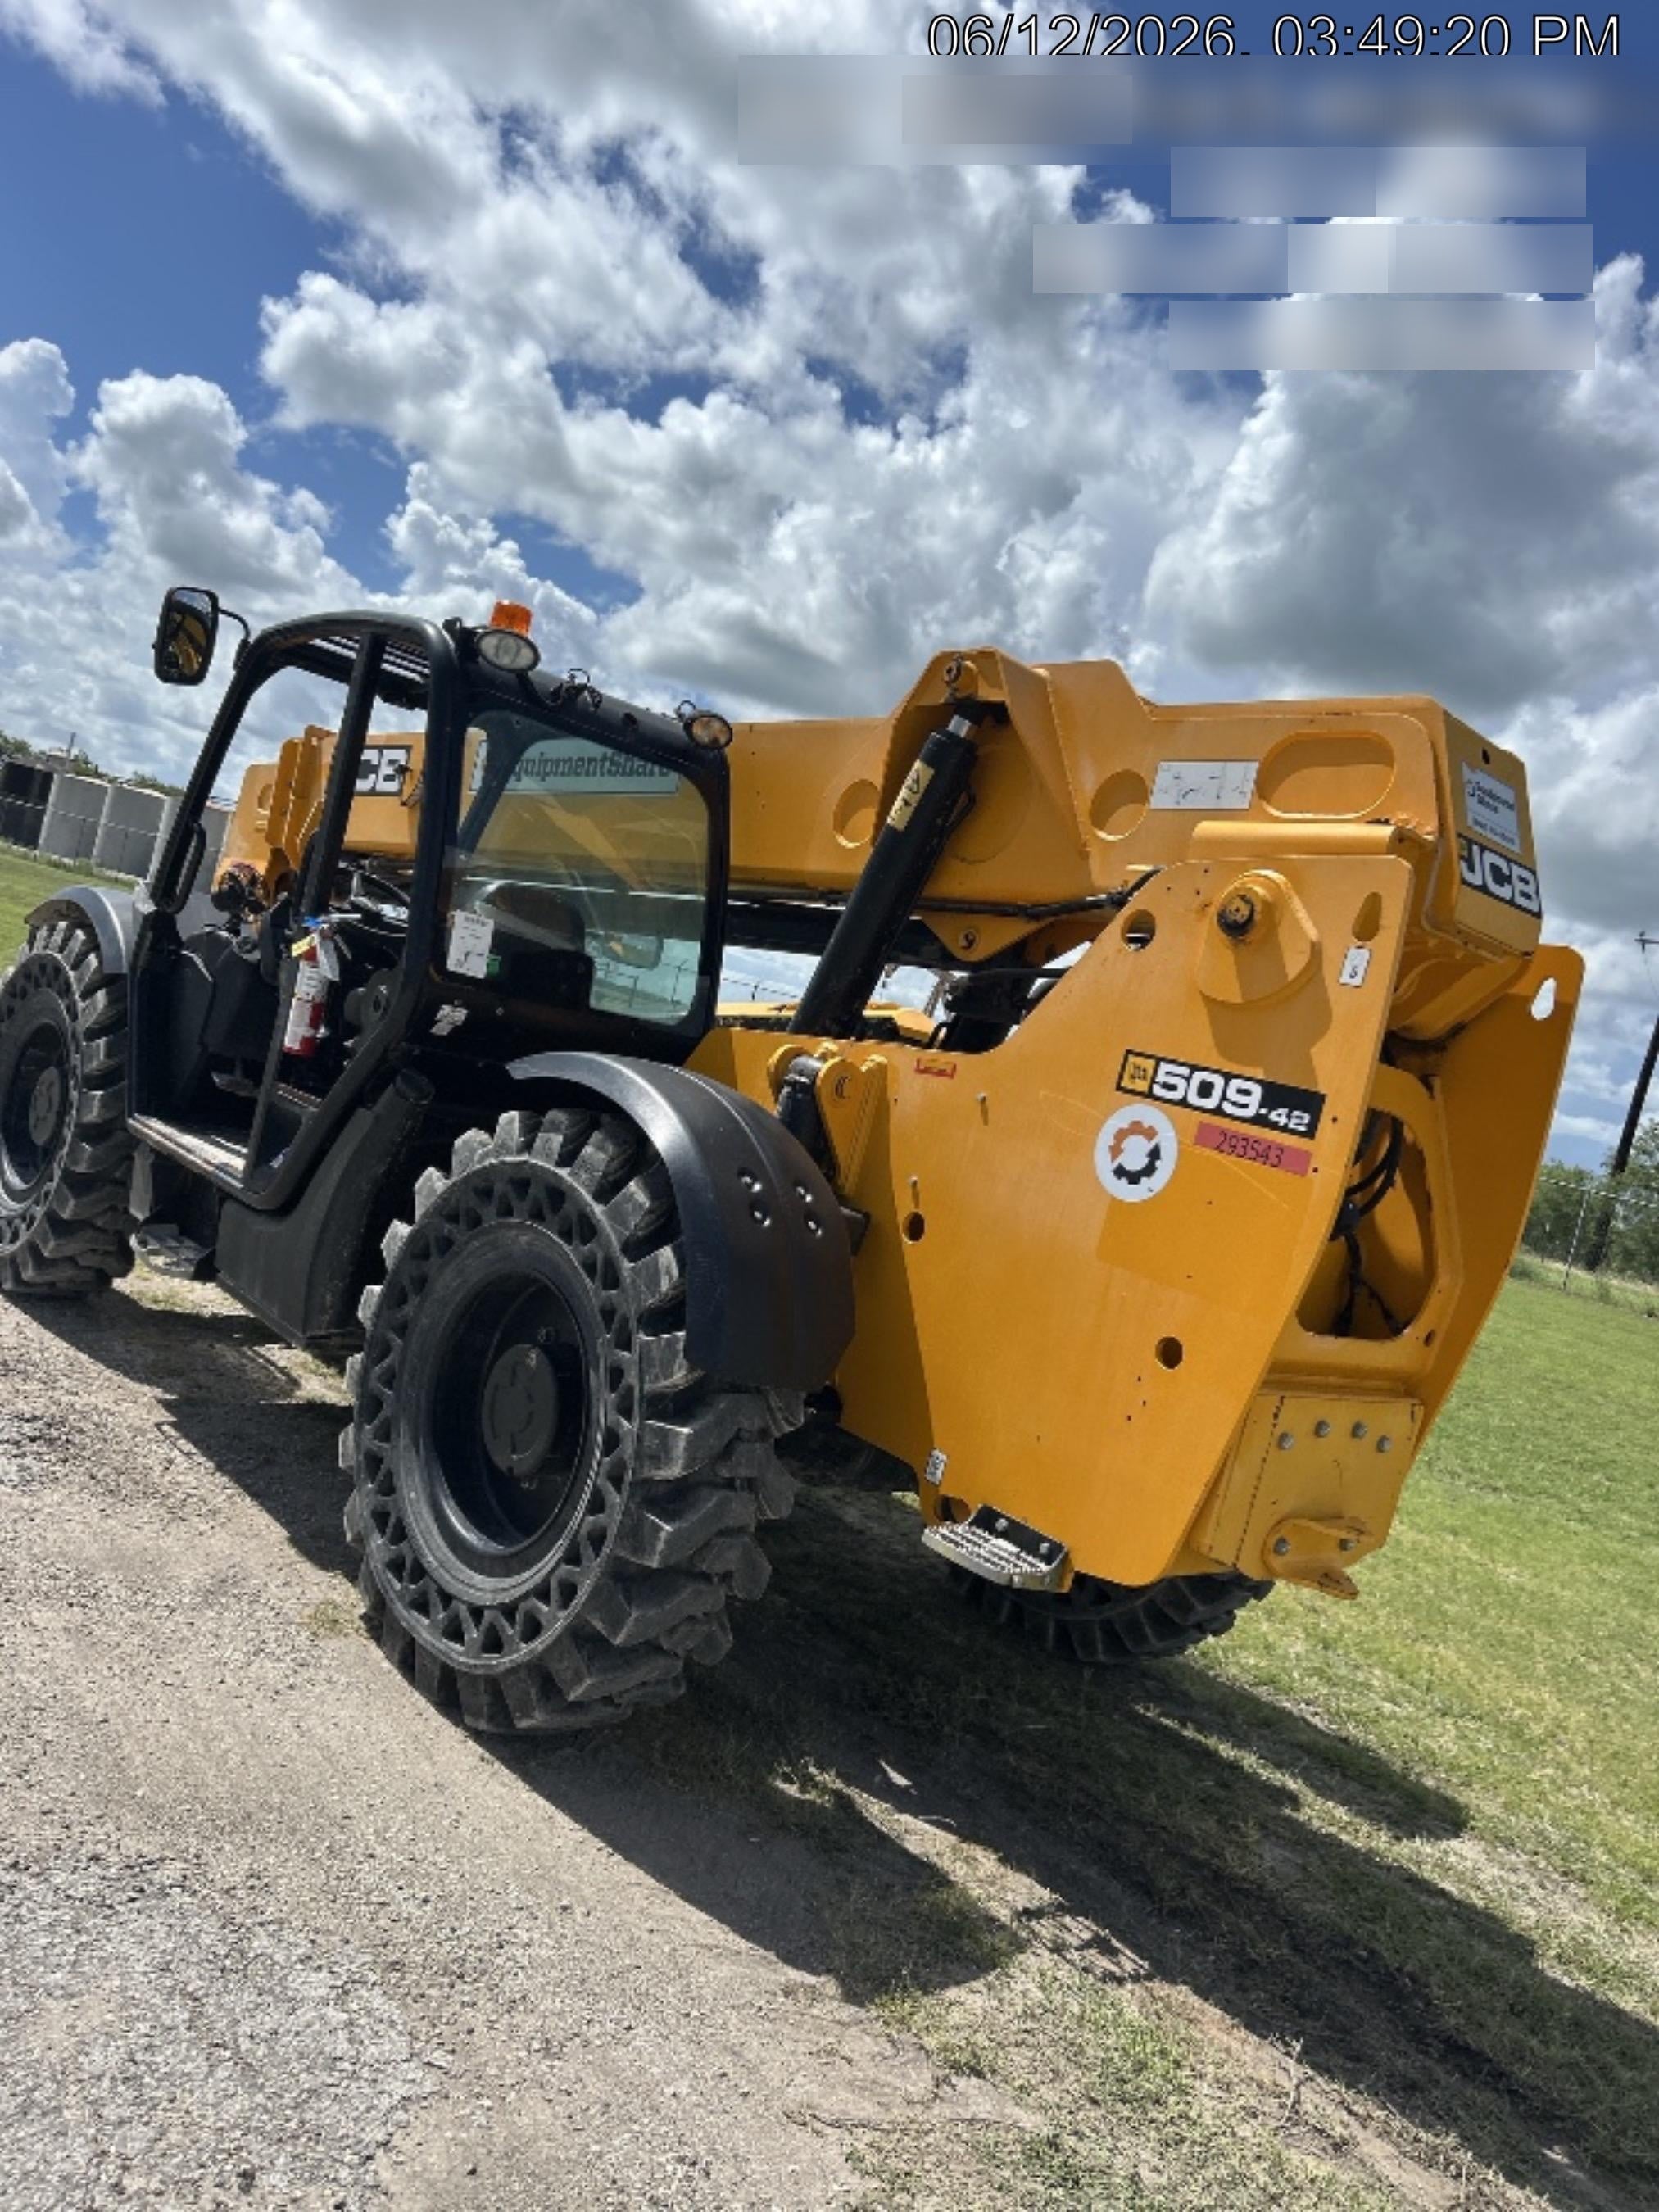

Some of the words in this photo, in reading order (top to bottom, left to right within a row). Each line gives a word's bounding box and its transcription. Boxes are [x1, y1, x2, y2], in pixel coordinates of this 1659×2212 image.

[355, 749, 407, 792] CB
[513, 751, 670, 782] quipmentShare
[1460, 842, 1540, 913] JCB
[1213, 1130, 1285, 1168] 293543
